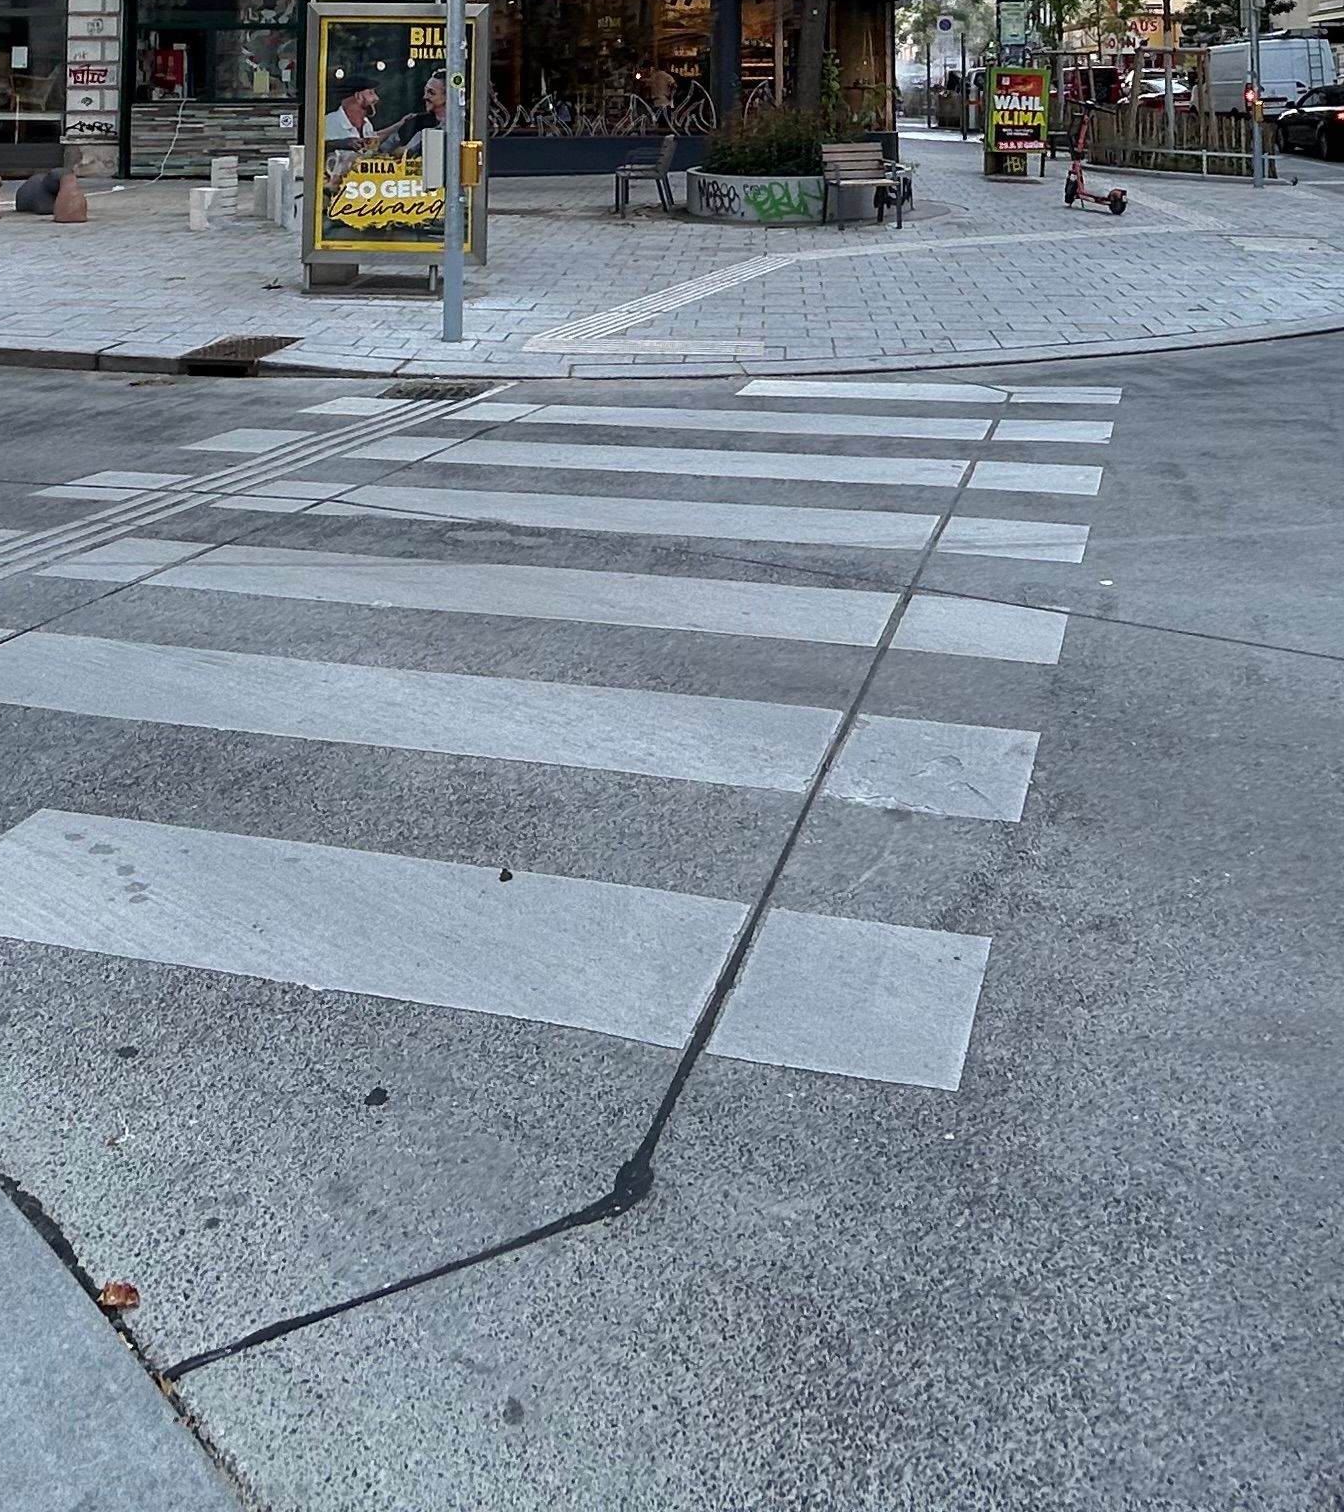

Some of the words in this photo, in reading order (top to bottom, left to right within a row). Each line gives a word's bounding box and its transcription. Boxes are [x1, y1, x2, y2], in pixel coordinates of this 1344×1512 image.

[993, 110, 1045, 126] KLIMA
[360, 162, 396, 174] BILLA
[344, 181, 377, 200] SO
[380, 179, 438, 198] GEH
